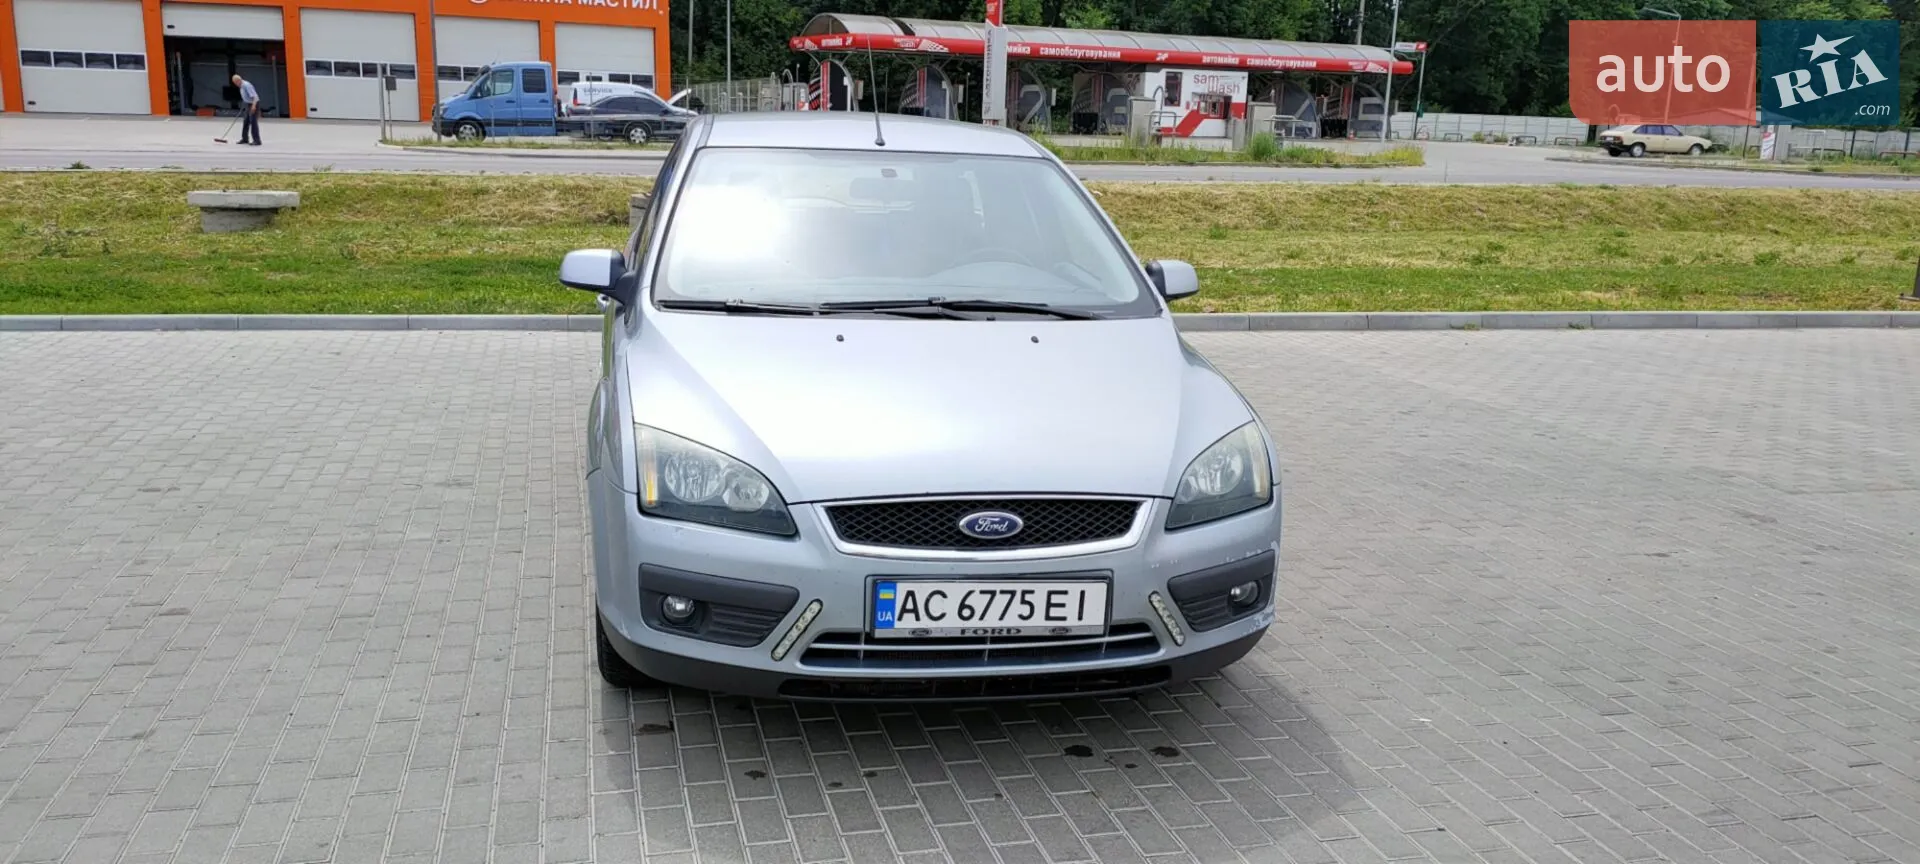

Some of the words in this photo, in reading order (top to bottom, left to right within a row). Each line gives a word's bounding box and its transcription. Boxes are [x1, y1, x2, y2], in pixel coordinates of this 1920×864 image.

[974, 517, 1009, 532] Ford
[897, 589, 949, 622] AC
[957, 589, 1036, 622] 6775
[877, 611, 893, 622] UA
[960, 627, 1022, 636] FORD
